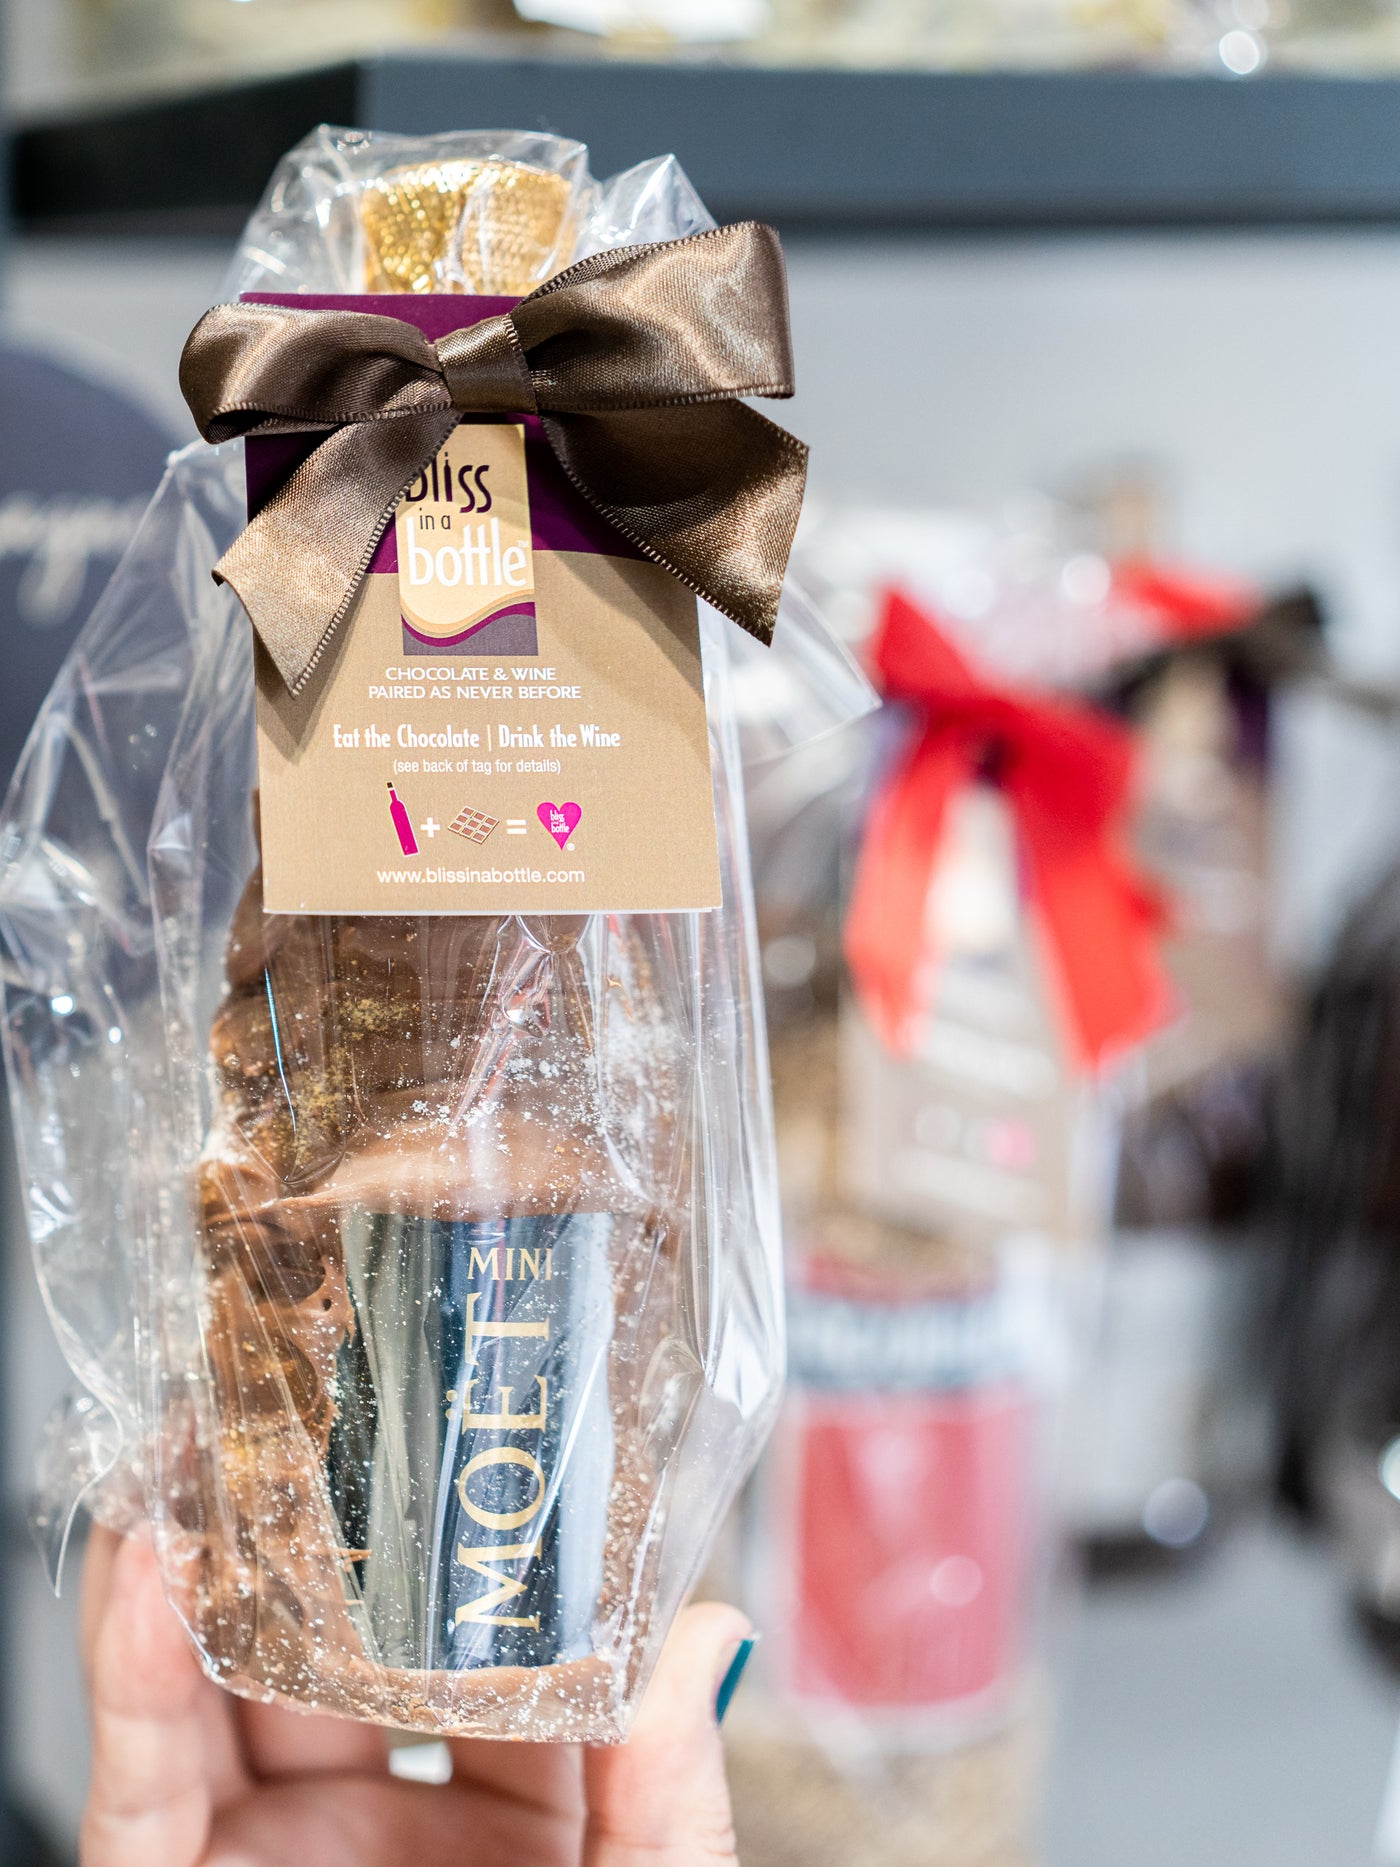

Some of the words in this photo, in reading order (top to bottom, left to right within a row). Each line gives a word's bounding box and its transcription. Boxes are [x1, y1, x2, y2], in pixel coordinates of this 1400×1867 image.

[418, 507, 435, 530] in
[440, 514, 451, 530] a
[385, 667, 489, 681] CHOCOLATE
[493, 667, 508, 681] &
[511, 667, 557, 681] WINE
[368, 685, 426, 699] PAIRED
[430, 685, 451, 699] AS
[456, 685, 514, 699] NEVER
[518, 685, 582, 699] BEFORE
[333, 723, 361, 748] Eat
[364, 724, 391, 748] the
[397, 724, 480, 748] Chocolate
[498, 724, 545, 748] Drink
[549, 724, 578, 748] the
[579, 723, 621, 748] Wine
[393, 759, 419, 775] (see
[423, 758, 453, 773] back
[456, 758, 469, 773] of
[471, 759, 492, 776] tag
[494, 758, 513, 773] for
[516, 758, 561, 776] details)
[377, 867, 586, 883] www.blissinabottle.com
[467, 1246, 553, 1281] MINI
